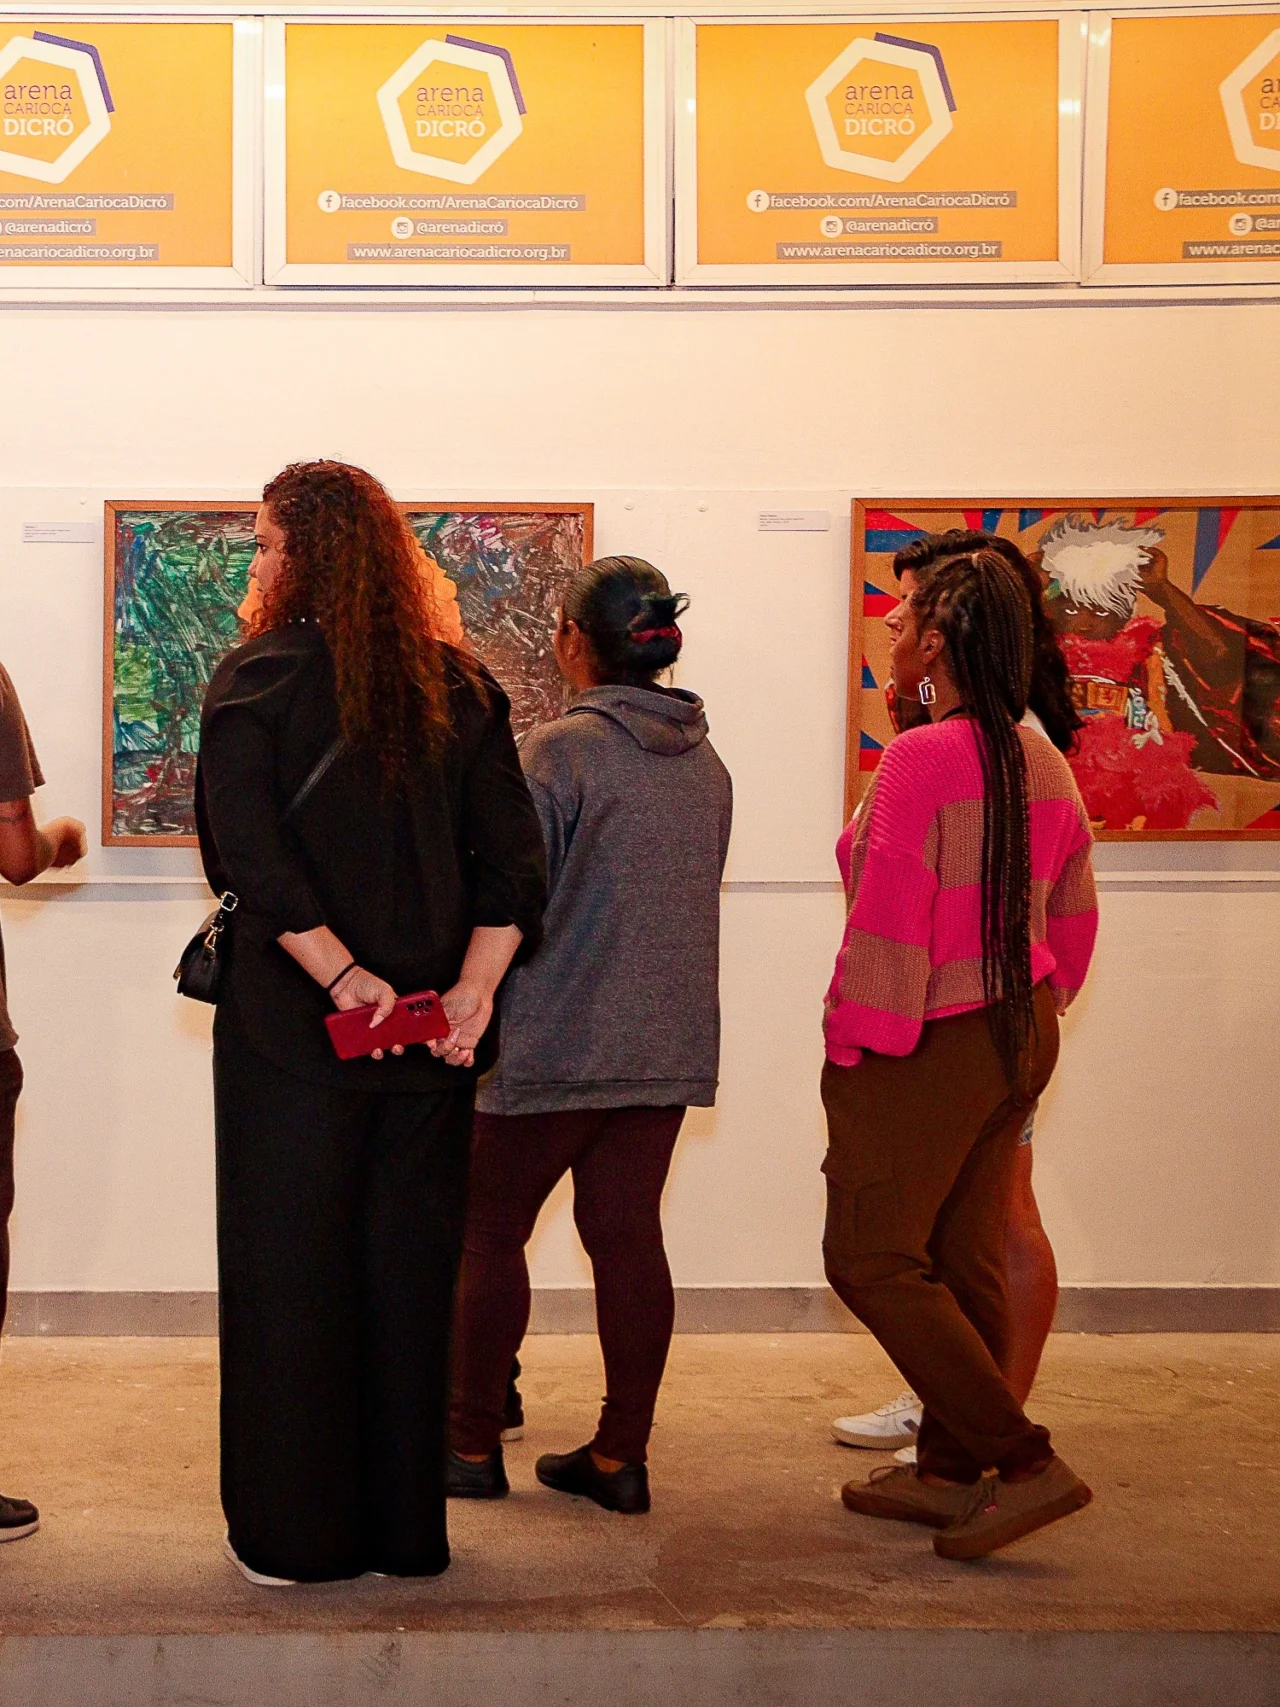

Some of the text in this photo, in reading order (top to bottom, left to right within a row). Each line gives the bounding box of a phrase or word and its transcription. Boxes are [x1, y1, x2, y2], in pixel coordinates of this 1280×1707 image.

[4, 84, 72, 100] arena
[416, 86, 484, 102] arena
[845, 84, 914, 101] arena
[3, 102, 72, 115] CARIOCA
[416, 104, 484, 117] CARIOCA
[845, 102, 913, 115] CARIOCA
[3, 115, 74, 136] DICRÓ
[415, 116, 486, 138] DICRÓ
[844, 115, 916, 136] DICRÓ
[342, 195, 578, 210] facebook.com/ArenaCariocaDicró
[770, 193, 1010, 208] facebook.com/ArenaCariocaDicró
[5, 220, 92, 234] @arenadicró
[416, 220, 504, 235] @arenadicró
[846, 219, 934, 232] @arenadicró
[353, 245, 567, 261] www.arenacariocadicro.org.br
[782, 243, 997, 259] www.arenacariocadicro.org.br
